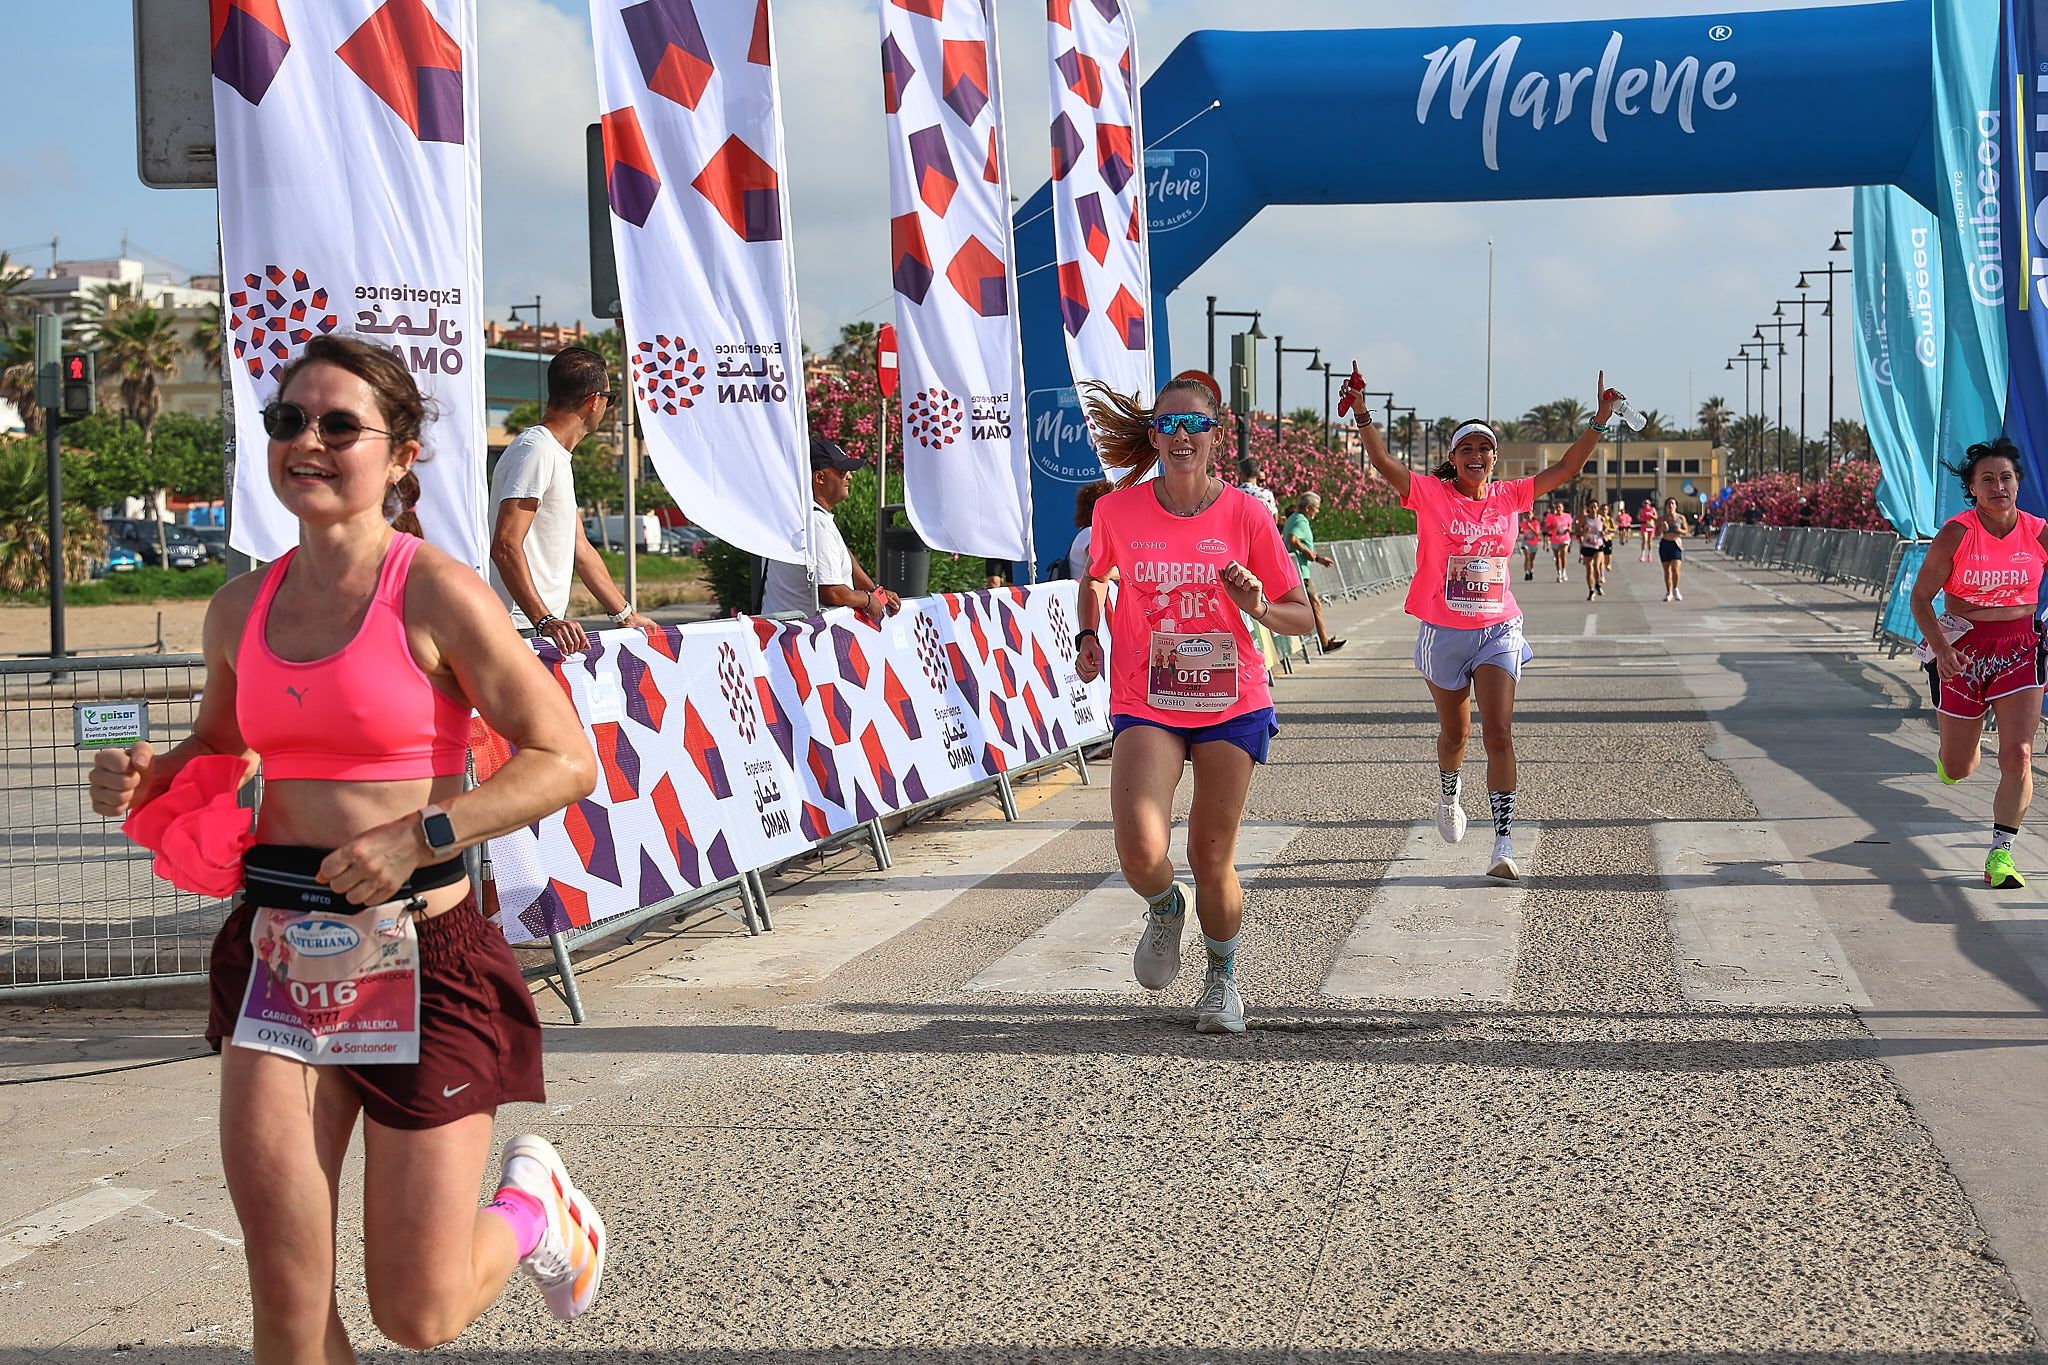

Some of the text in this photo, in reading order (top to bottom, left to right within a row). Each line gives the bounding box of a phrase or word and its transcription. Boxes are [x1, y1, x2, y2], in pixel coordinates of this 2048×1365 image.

[1416, 30, 1737, 171] Marlene
[1148, 168, 1200, 203] rlene
[1166, 208, 1193, 226] ALPES
[1041, 456, 1059, 473] HIJA
[1061, 466, 1075, 476] DE
[1077, 467, 1096, 477] LOS
[1130, 541, 1167, 550] OYSHO
[1134, 561, 1218, 585] CARRERA
[1963, 569, 2029, 586] CARRERA
[1467, 581, 1490, 592] 016
[1178, 669, 1211, 683] 016
[1158, 698, 1185, 707] OYSHO
[948, 745, 976, 770] OMAN
[761, 808, 792, 839] OMAN
[289, 929, 354, 949] ASTURIANA
[290, 981, 358, 1008] 016
[261, 1009, 302, 1026] CARRERA
[319, 1020, 350, 1036] MUJER
[357, 1019, 398, 1031] VALENCIA
[307, 1010, 340, 1025] 2177
[257, 1028, 398, 1054] OYSHO Santander
